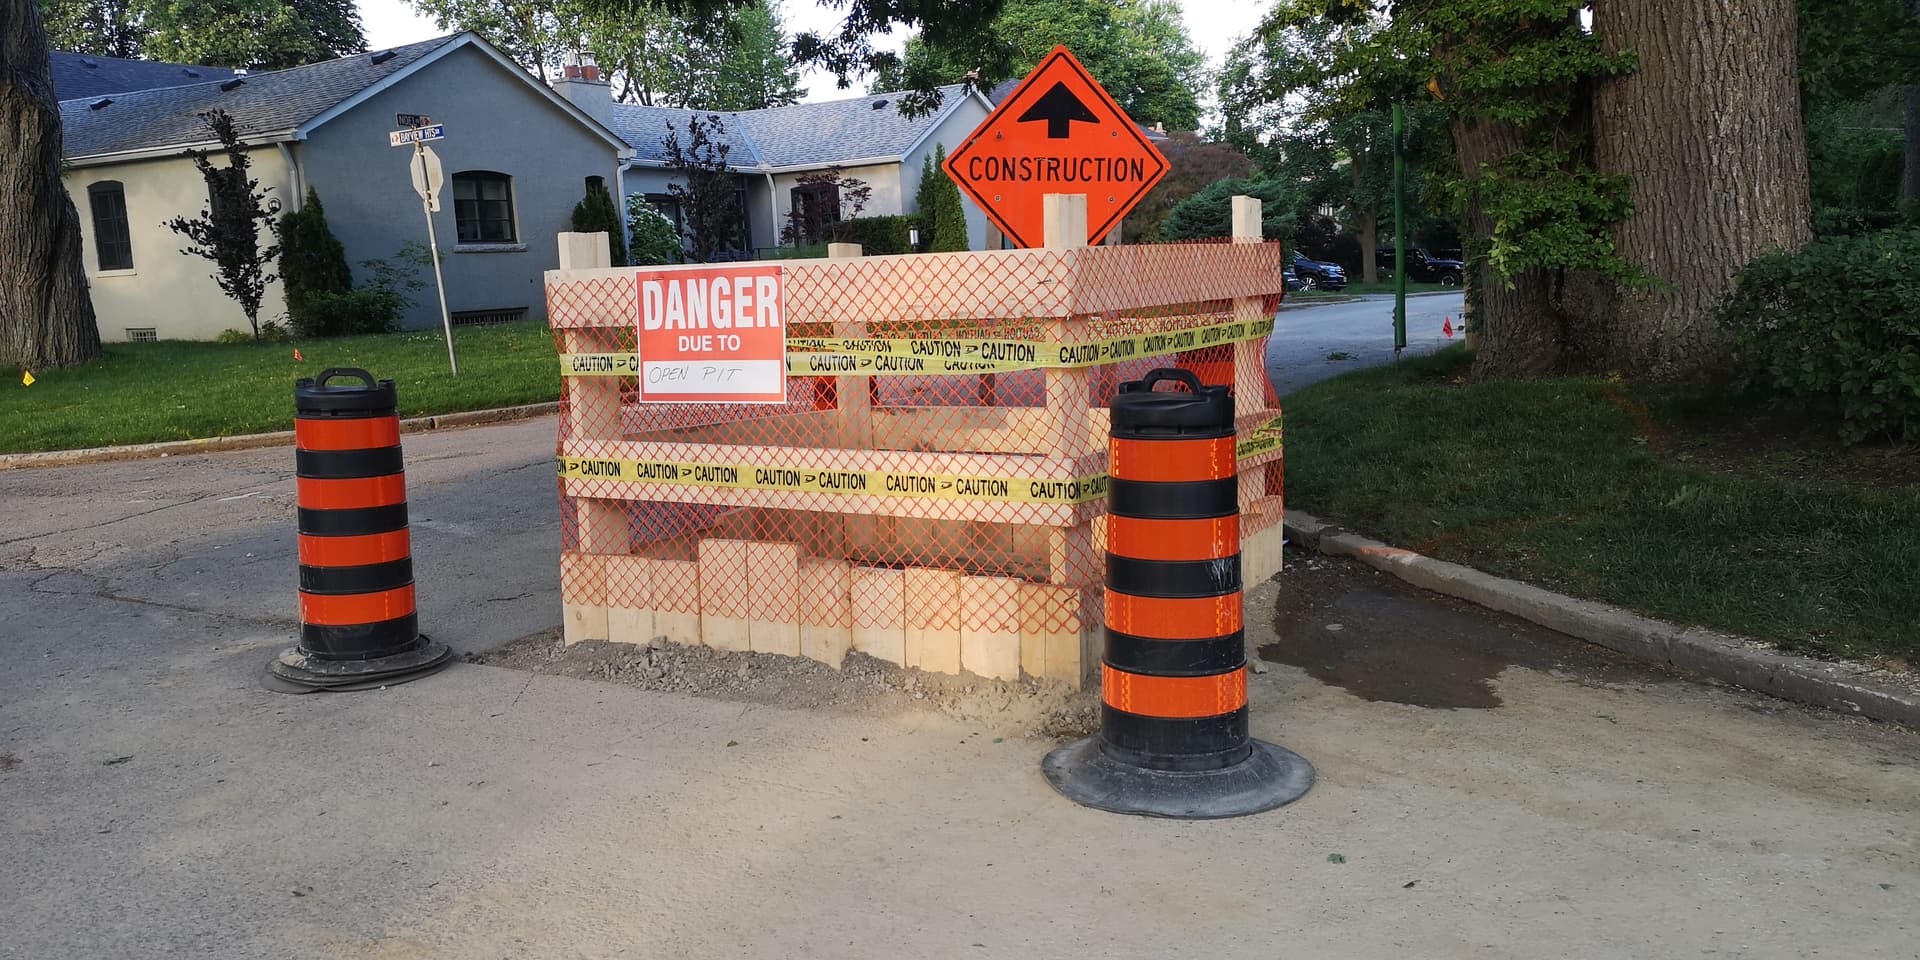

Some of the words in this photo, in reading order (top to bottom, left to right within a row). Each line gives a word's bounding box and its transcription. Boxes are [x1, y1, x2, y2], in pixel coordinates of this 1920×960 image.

[969, 156, 1144, 182] CONSTRUCTION
[642, 276, 780, 330] DANGER
[678, 335, 713, 352] DUE
[717, 335, 741, 351] TO
[910, 340, 961, 358] CAUTION
[981, 342, 1035, 362] CAUTION
[1060, 344, 1100, 363] CAUTION
[1110, 338, 1136, 359] CAUTION
[1143, 334, 1166, 353] CAUTION
[573, 356, 613, 372] CAUTION
[809, 355, 857, 371] CAUTION
[875, 355, 924, 371] CAUTION
[649, 366, 689, 384] OPEN
[702, 366, 743, 382] PIT
[581, 460, 621, 477] CAUTION
[637, 462, 678, 479] CAUTION
[695, 466, 738, 483] CAUTION
[755, 468, 801, 486] CAUTION
[819, 472, 866, 490] CAUTION
[886, 475, 936, 493] CAUTION
[956, 478, 1008, 497] CAUTION
[1030, 481, 1081, 500] CAUTION
